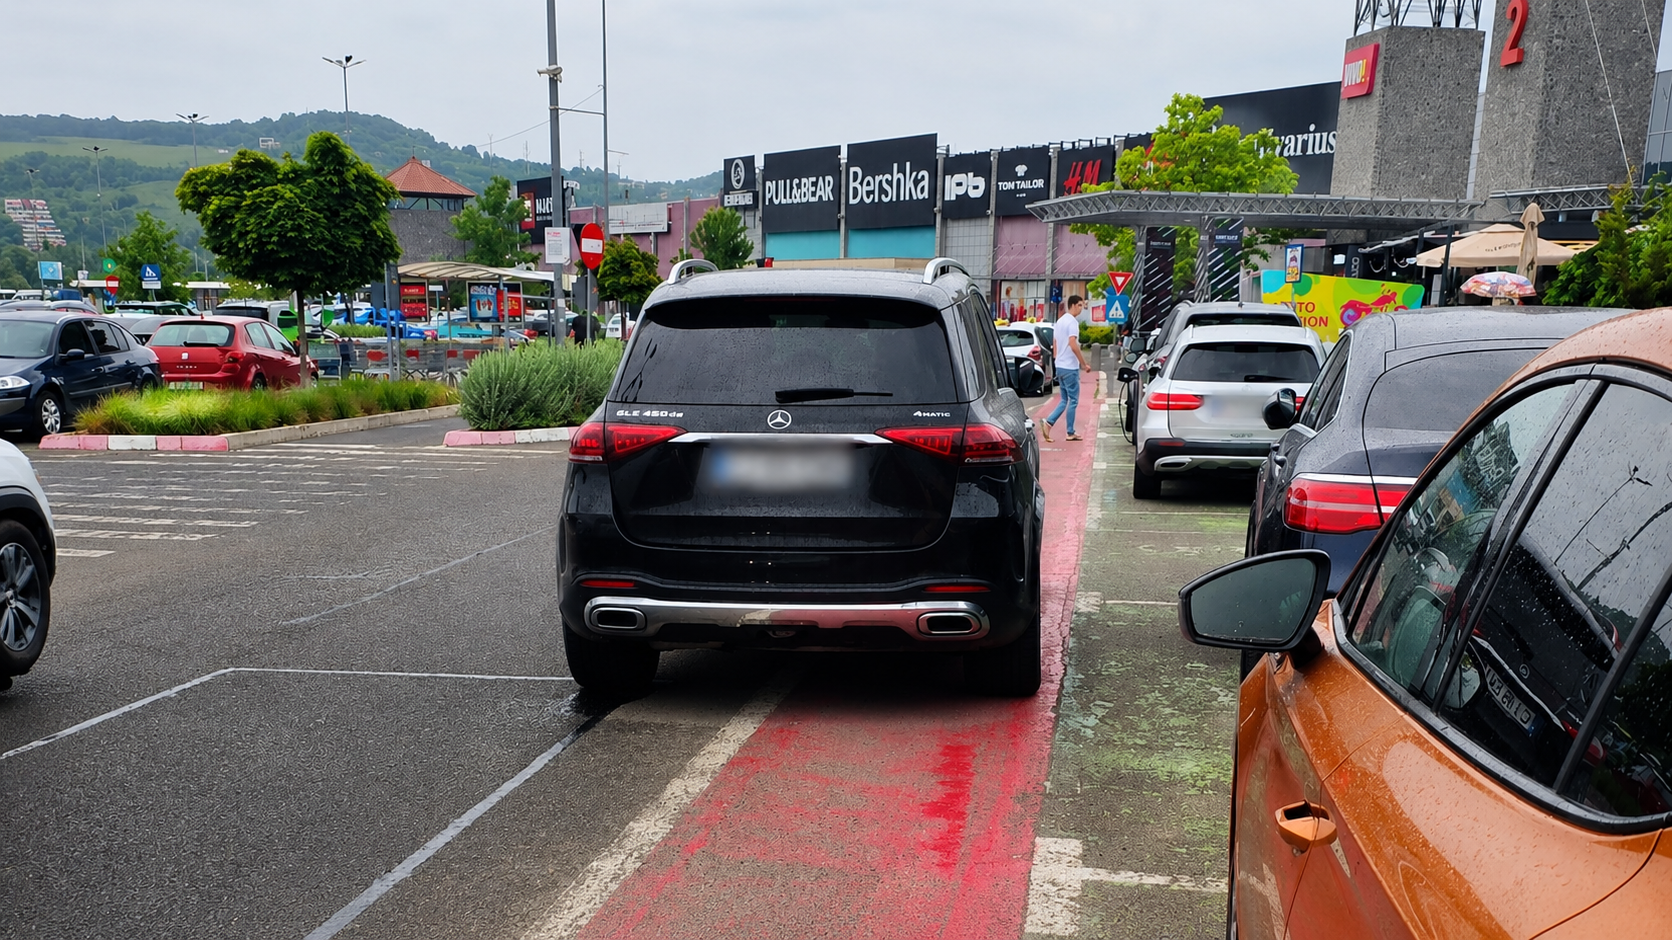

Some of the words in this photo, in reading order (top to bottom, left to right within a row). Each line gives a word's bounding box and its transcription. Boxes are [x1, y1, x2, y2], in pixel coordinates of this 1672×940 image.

[1500, 0, 1531, 67] 2
[765, 175, 834, 205] PULL&BEAR
[849, 162, 929, 204] Bershka
[998, 181, 1014, 190] TOM
[1016, 179, 1044, 189] TAILOR
[616, 409, 640, 417] GLE
